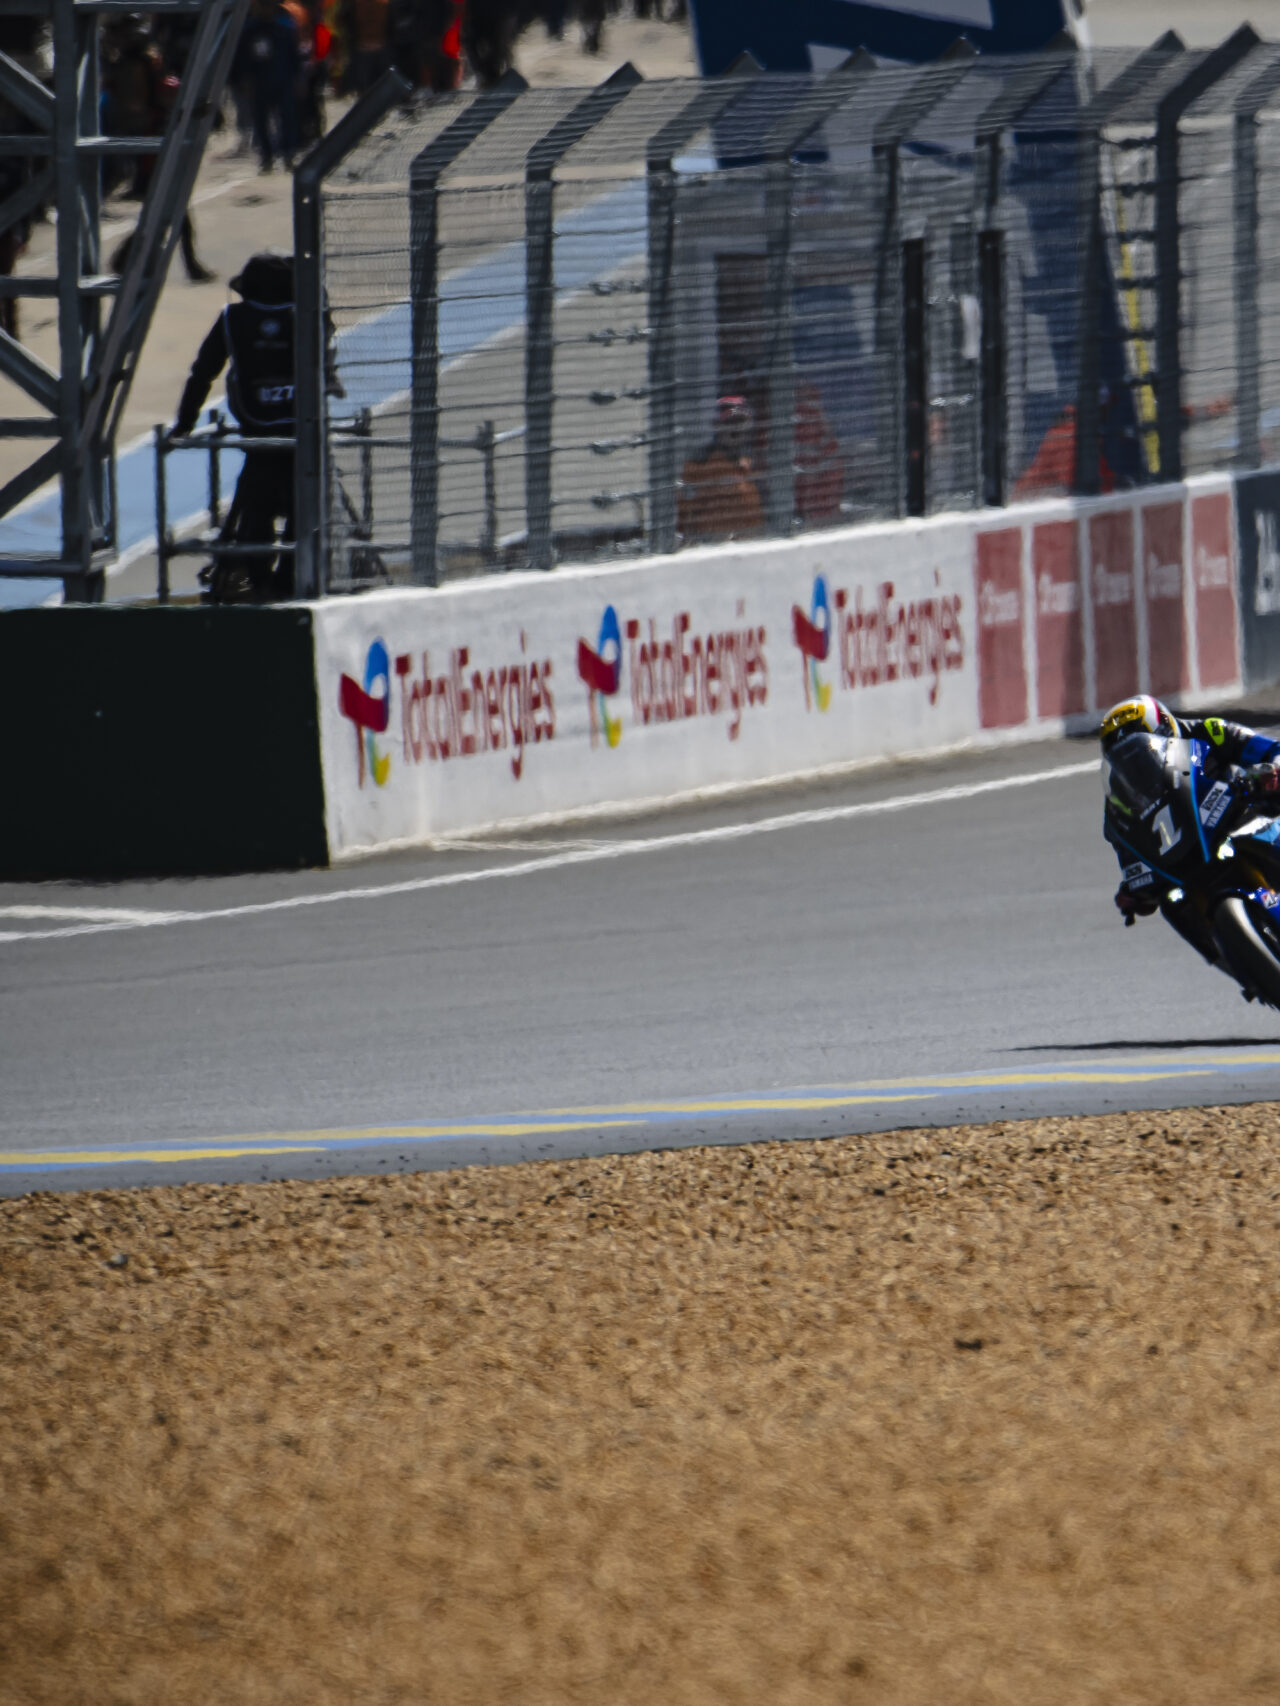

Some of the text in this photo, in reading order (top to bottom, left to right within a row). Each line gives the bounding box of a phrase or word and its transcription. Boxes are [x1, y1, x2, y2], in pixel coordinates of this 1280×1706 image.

[395, 628, 557, 781] TotalEnergies
[625, 598, 768, 742] TotalEnergies
[834, 568, 964, 706] TotalEnergies
[1152, 803, 1182, 856] 1
